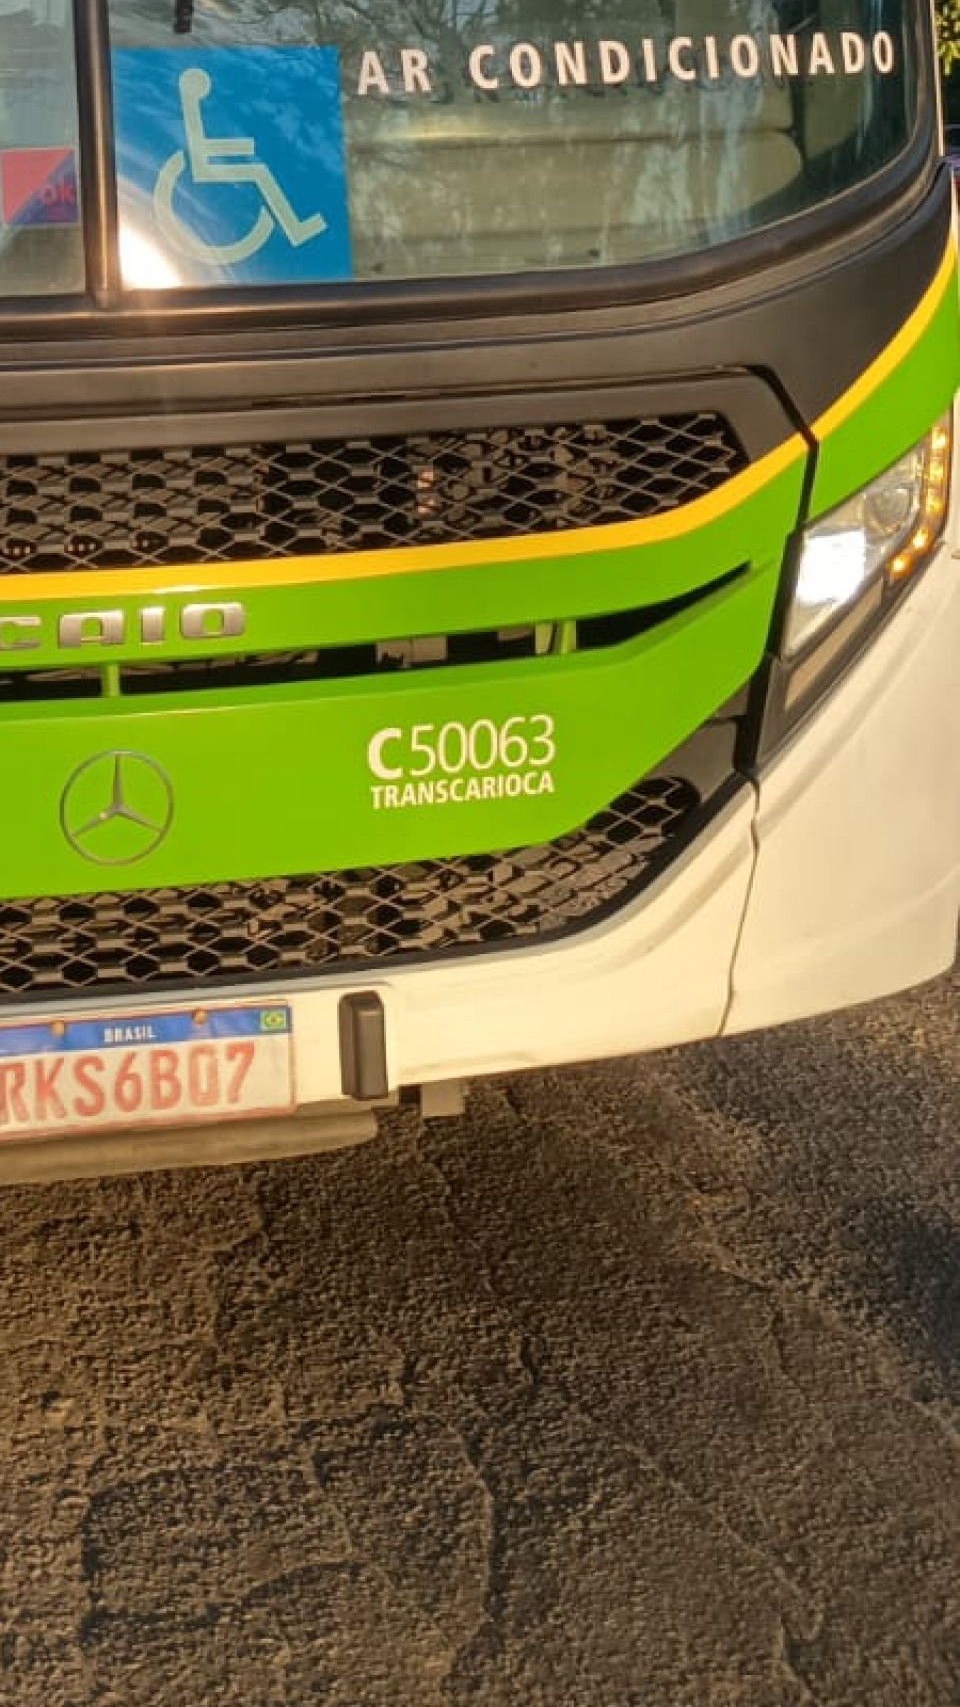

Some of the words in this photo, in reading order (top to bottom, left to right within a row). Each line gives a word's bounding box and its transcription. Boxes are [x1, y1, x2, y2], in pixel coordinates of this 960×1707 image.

[357, 48, 432, 95] AR
[468, 30, 895, 90] CONDICIONADO
[366, 713, 557, 781] C50063
[370, 770, 556, 811] TRANSCARIOCA
[103, 1024, 157, 1043] BRASIL
